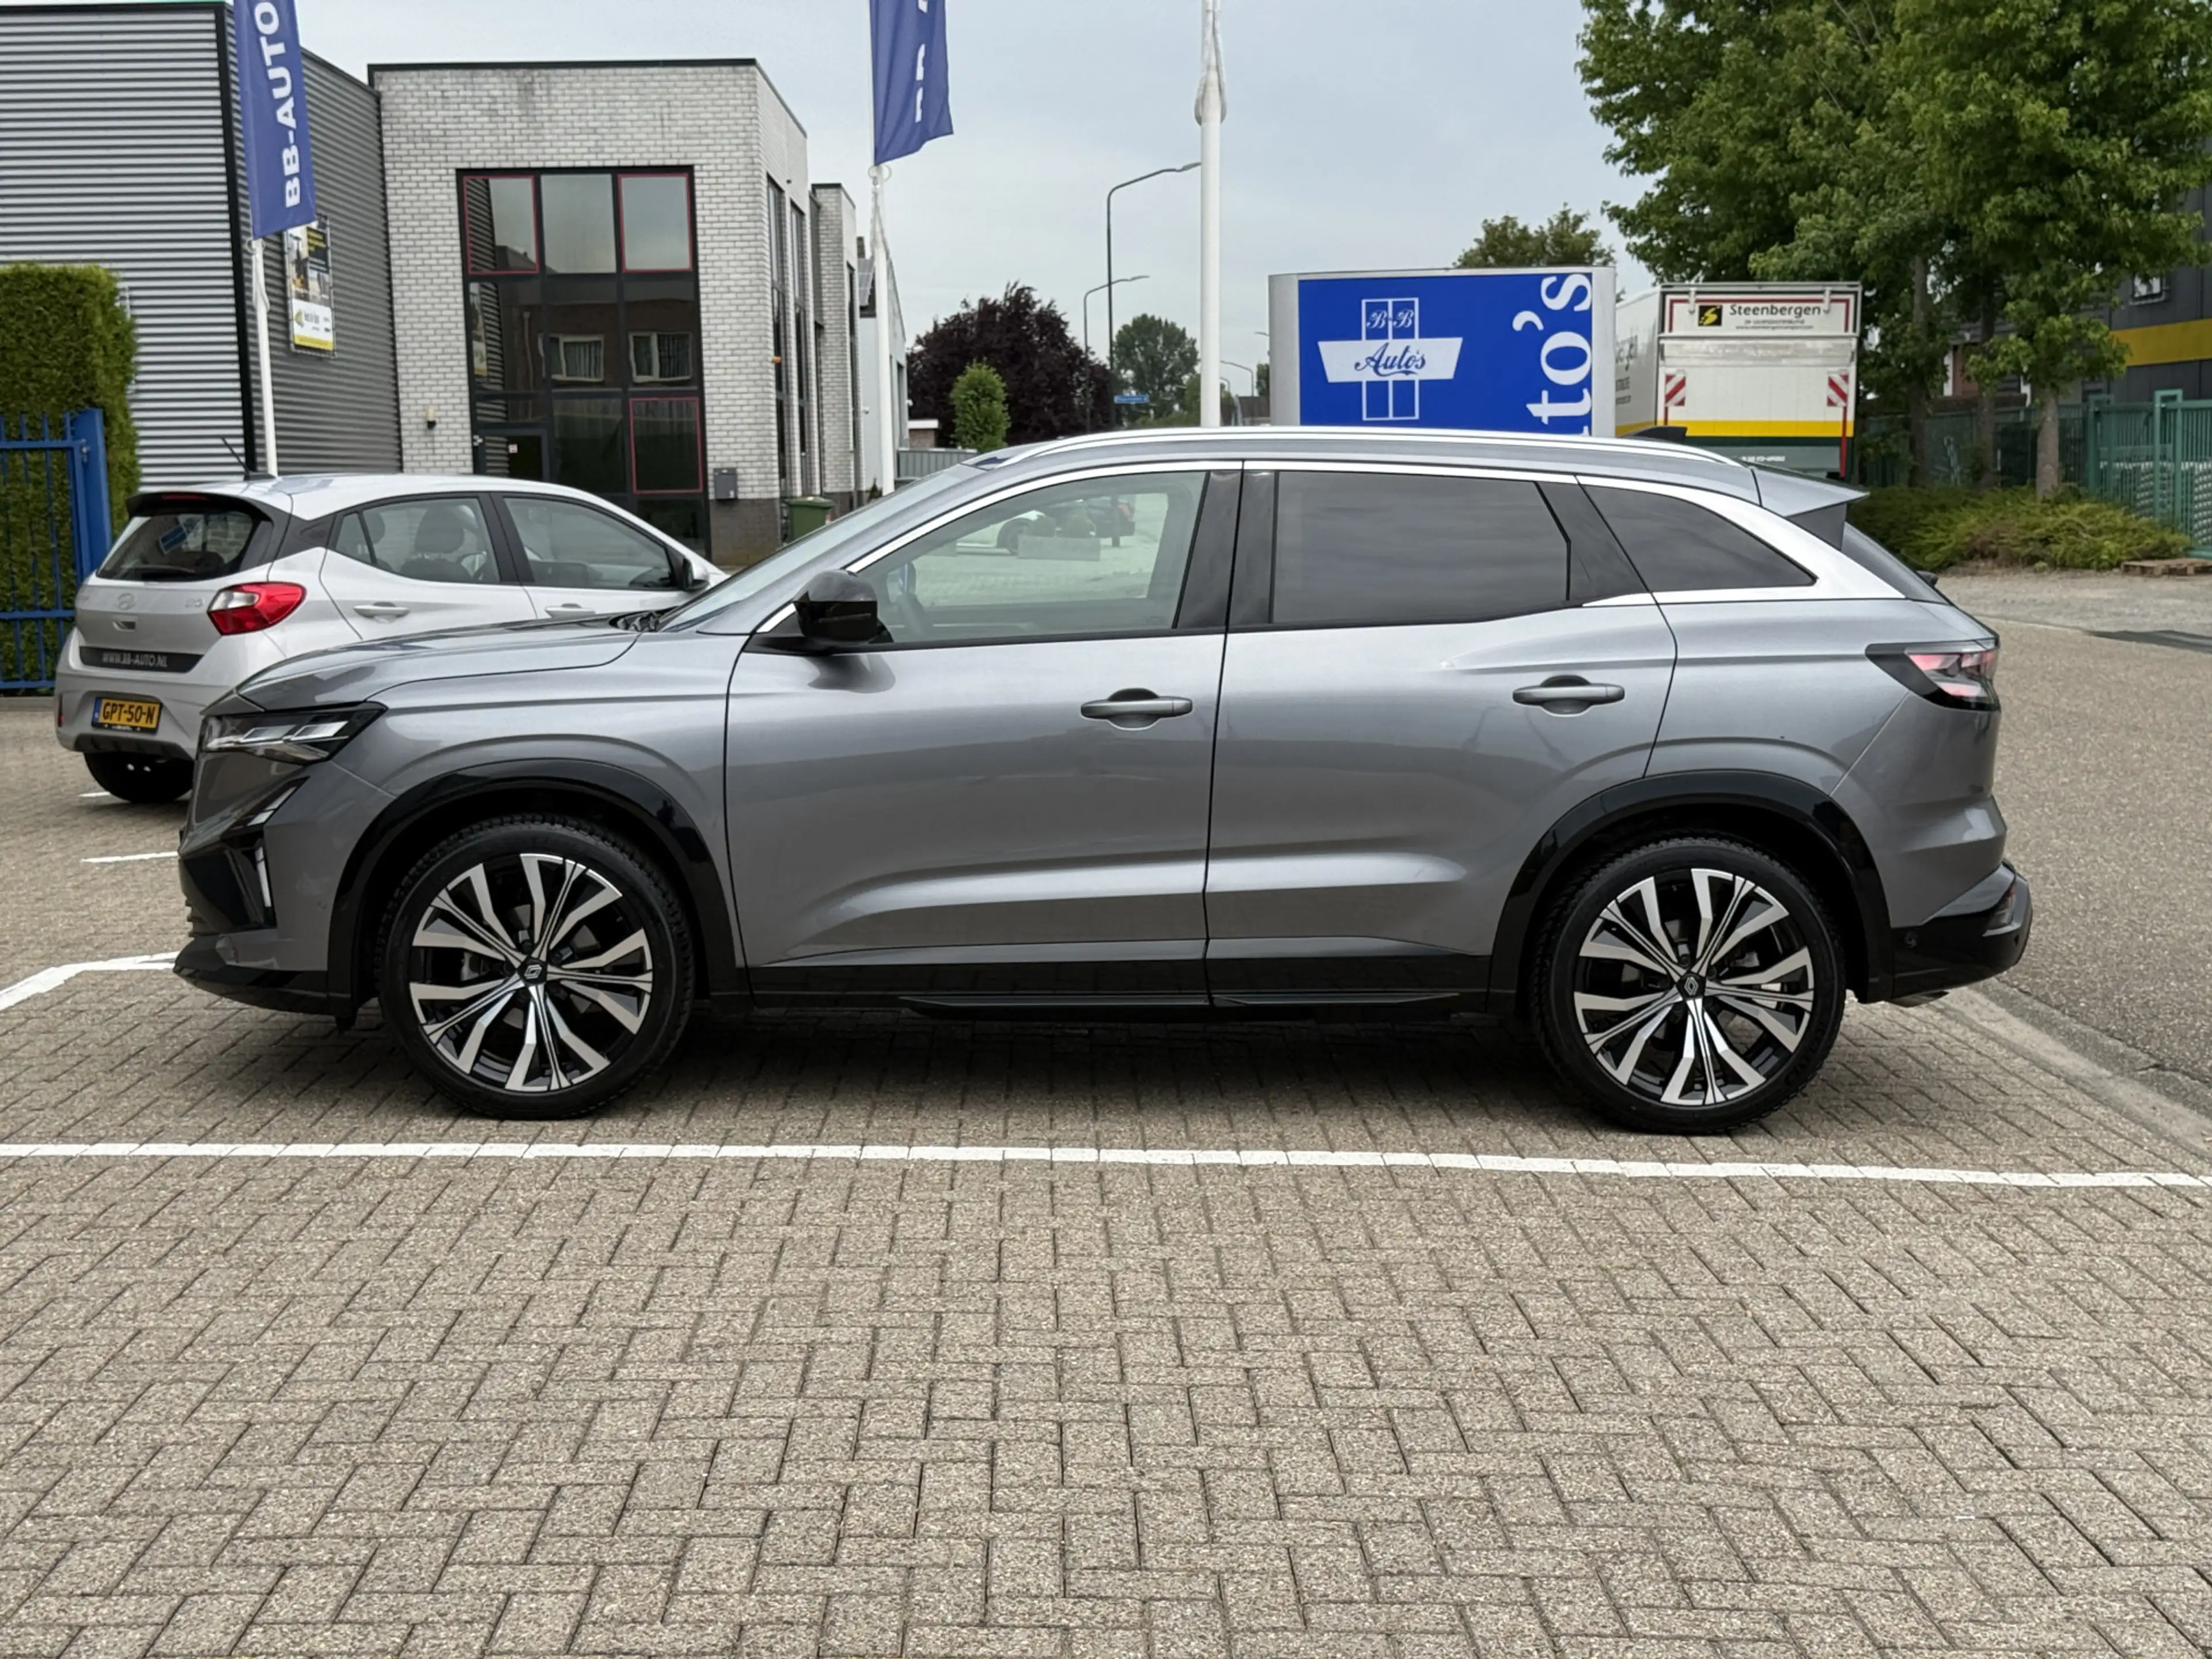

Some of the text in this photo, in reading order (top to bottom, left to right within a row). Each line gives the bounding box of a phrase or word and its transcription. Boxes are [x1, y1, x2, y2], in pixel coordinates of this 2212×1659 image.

[255, 2, 301, 207] BB-AUTO
[1729, 304, 1821, 318] Steenbergen
[1354, 342, 1426, 377] Auto's
[1512, 273, 1592, 435] to's
[103, 702, 156, 725] GPT-50-N
